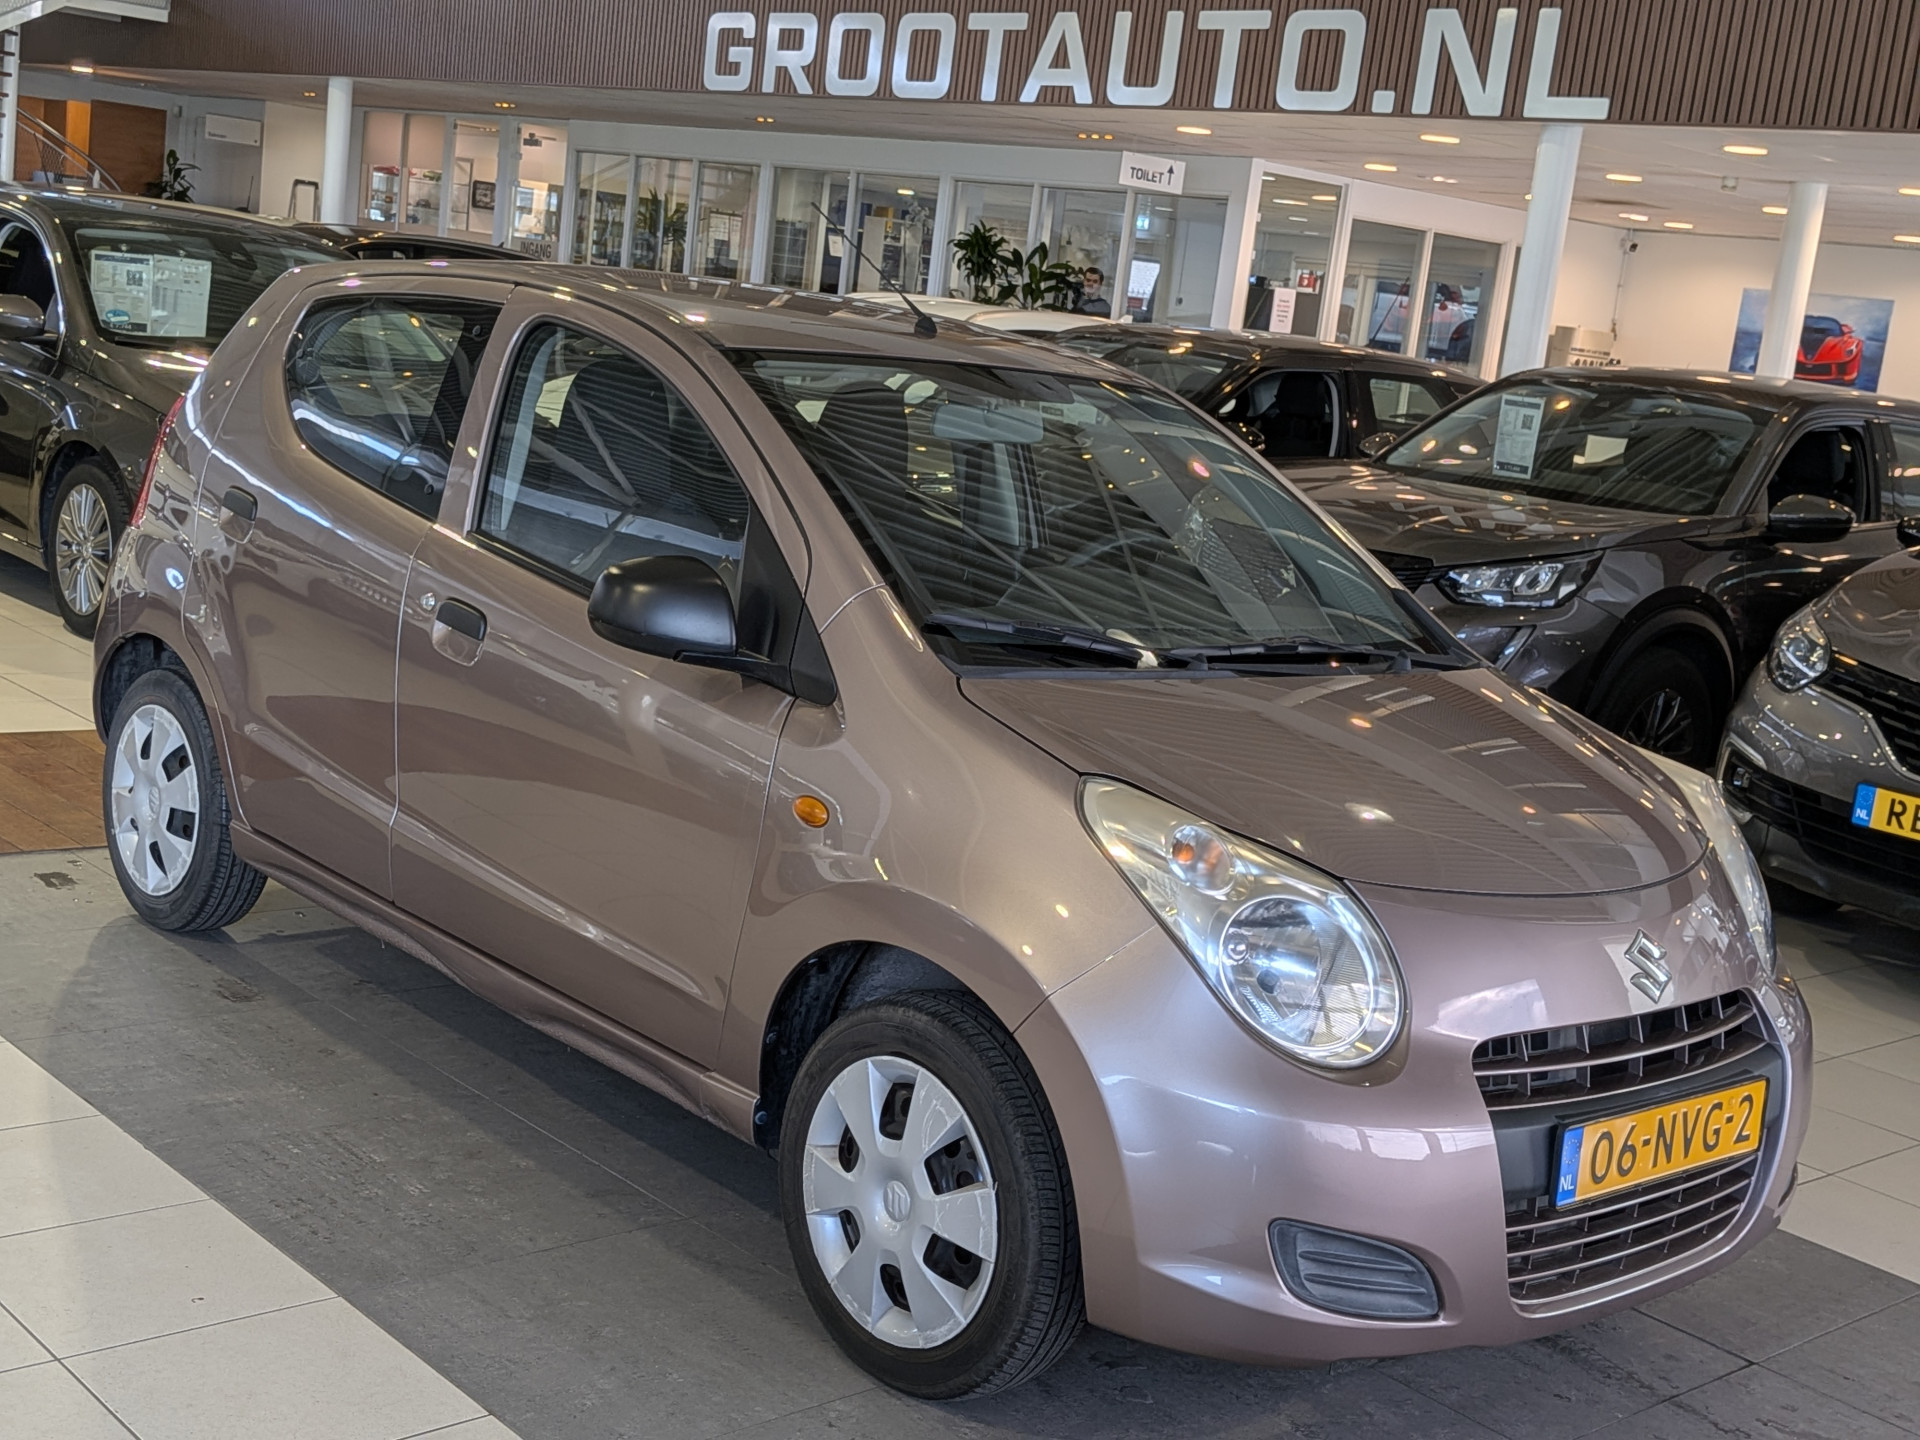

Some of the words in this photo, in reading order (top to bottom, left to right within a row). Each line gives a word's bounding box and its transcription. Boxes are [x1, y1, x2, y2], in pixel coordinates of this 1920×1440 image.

[703, 8, 1610, 120] GROOTAUTO.NL
[1130, 166, 1165, 185] TOILET
[521, 240, 552, 259] INGANG
[1855, 807, 1869, 820] NL
[1590, 1093, 1754, 1185] 06-NVG-2
[1559, 1173, 1575, 1193] NL
